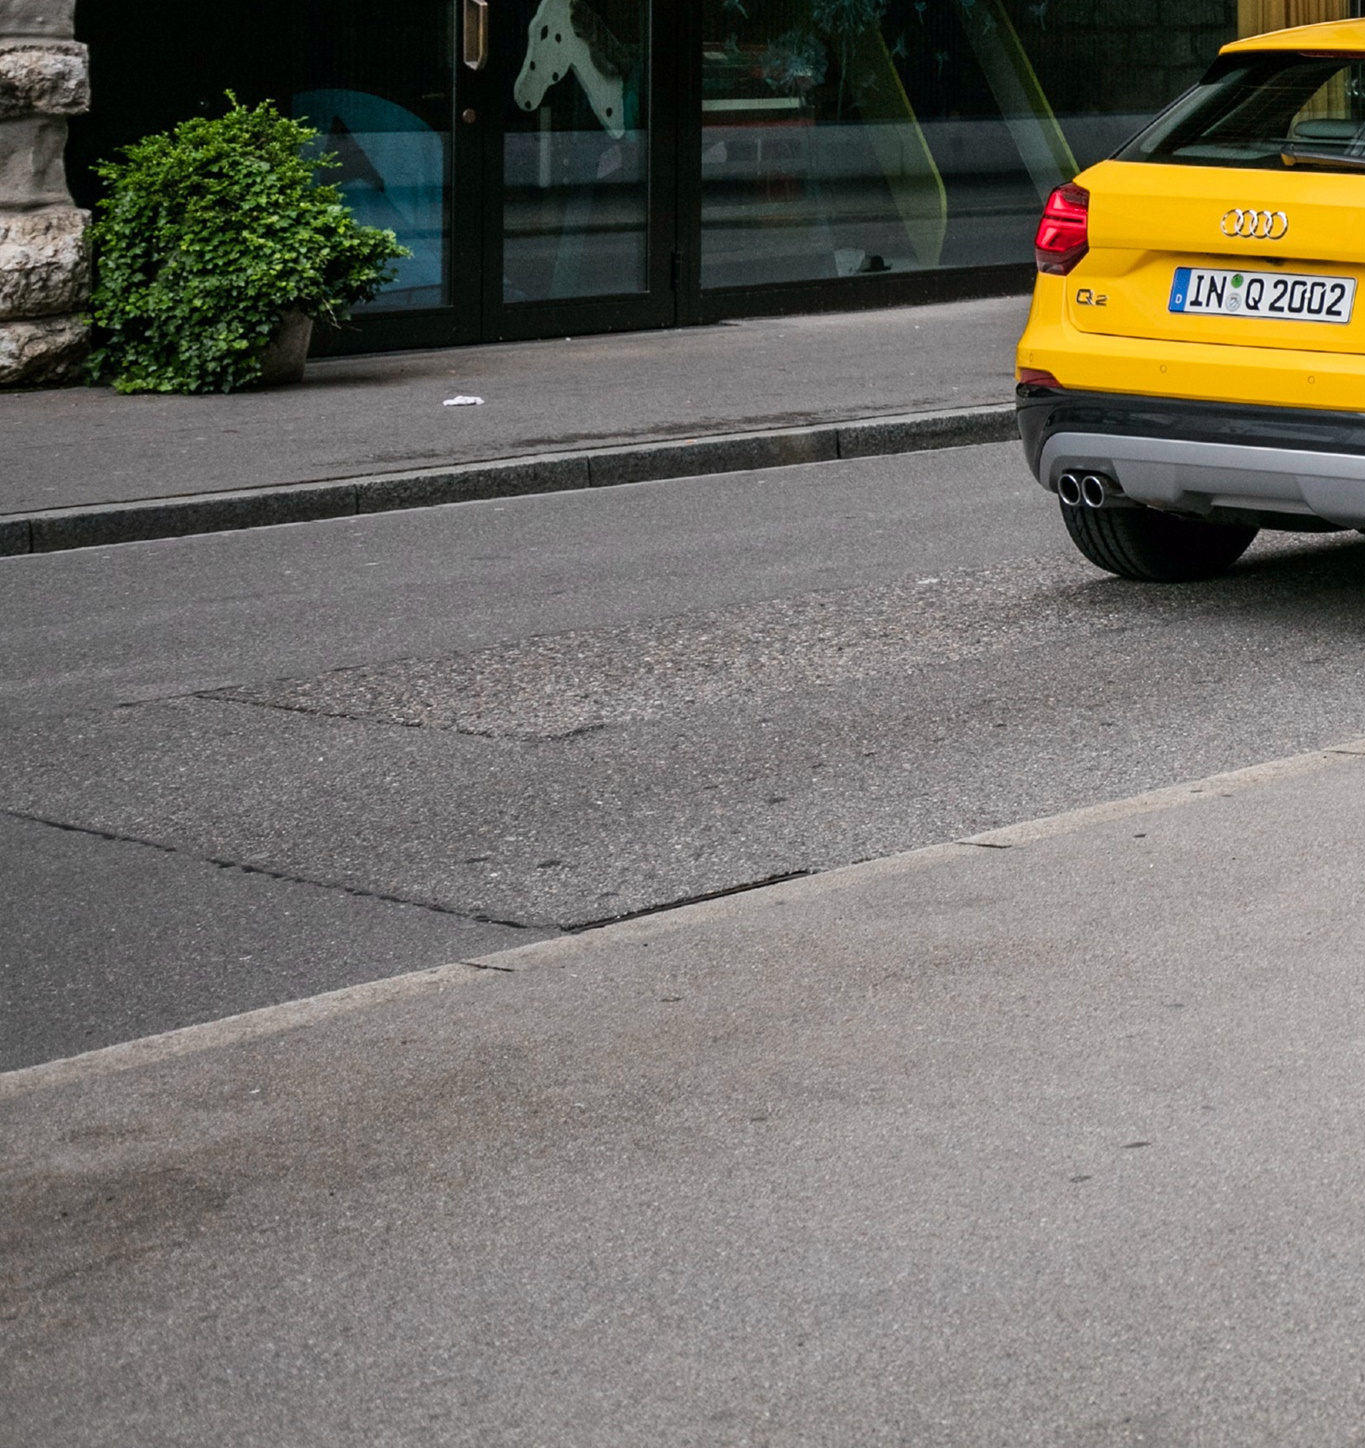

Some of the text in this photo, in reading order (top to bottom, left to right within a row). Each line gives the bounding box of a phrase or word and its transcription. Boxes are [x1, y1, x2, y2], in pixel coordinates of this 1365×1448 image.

[1076, 288, 1108, 306] Q2
[1175, 275, 1346, 316] D IN Q 2002
